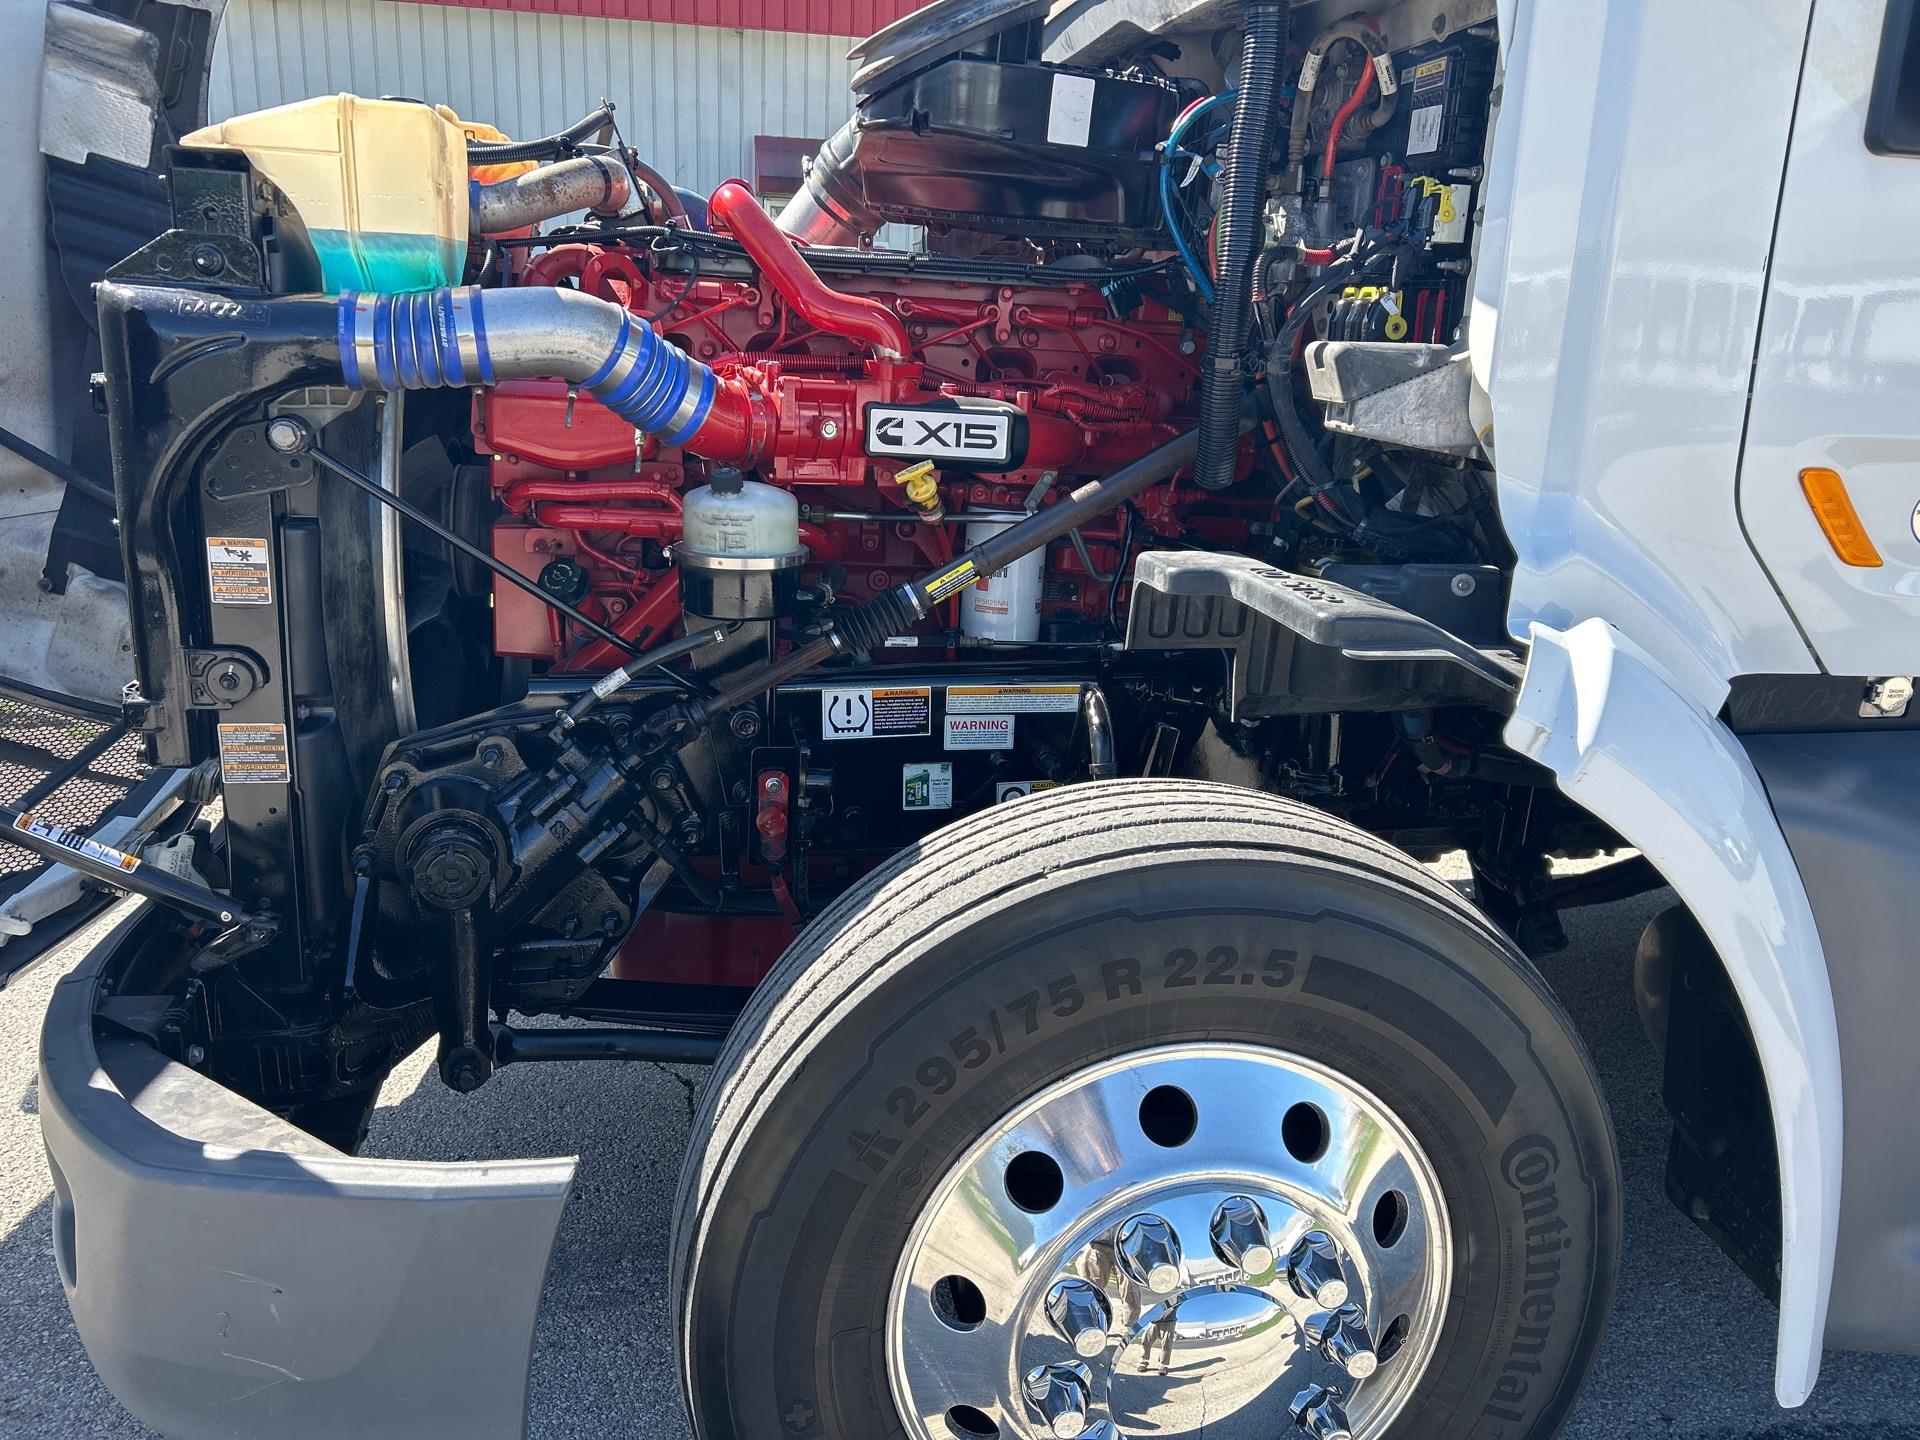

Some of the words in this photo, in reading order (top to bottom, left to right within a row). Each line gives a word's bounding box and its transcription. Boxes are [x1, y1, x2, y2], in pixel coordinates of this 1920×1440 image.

[437, 304, 449, 348] DYNACRAFT
[876, 418, 902, 434] Cummins
[913, 420, 998, 450] X15
[950, 720, 1009, 731] WARNING
[885, 974, 1085, 1129] 295/75
[1100, 957, 1144, 1001] R
[1163, 945, 1299, 989] 22.5
[1482, 1132, 1573, 1424] Continental
